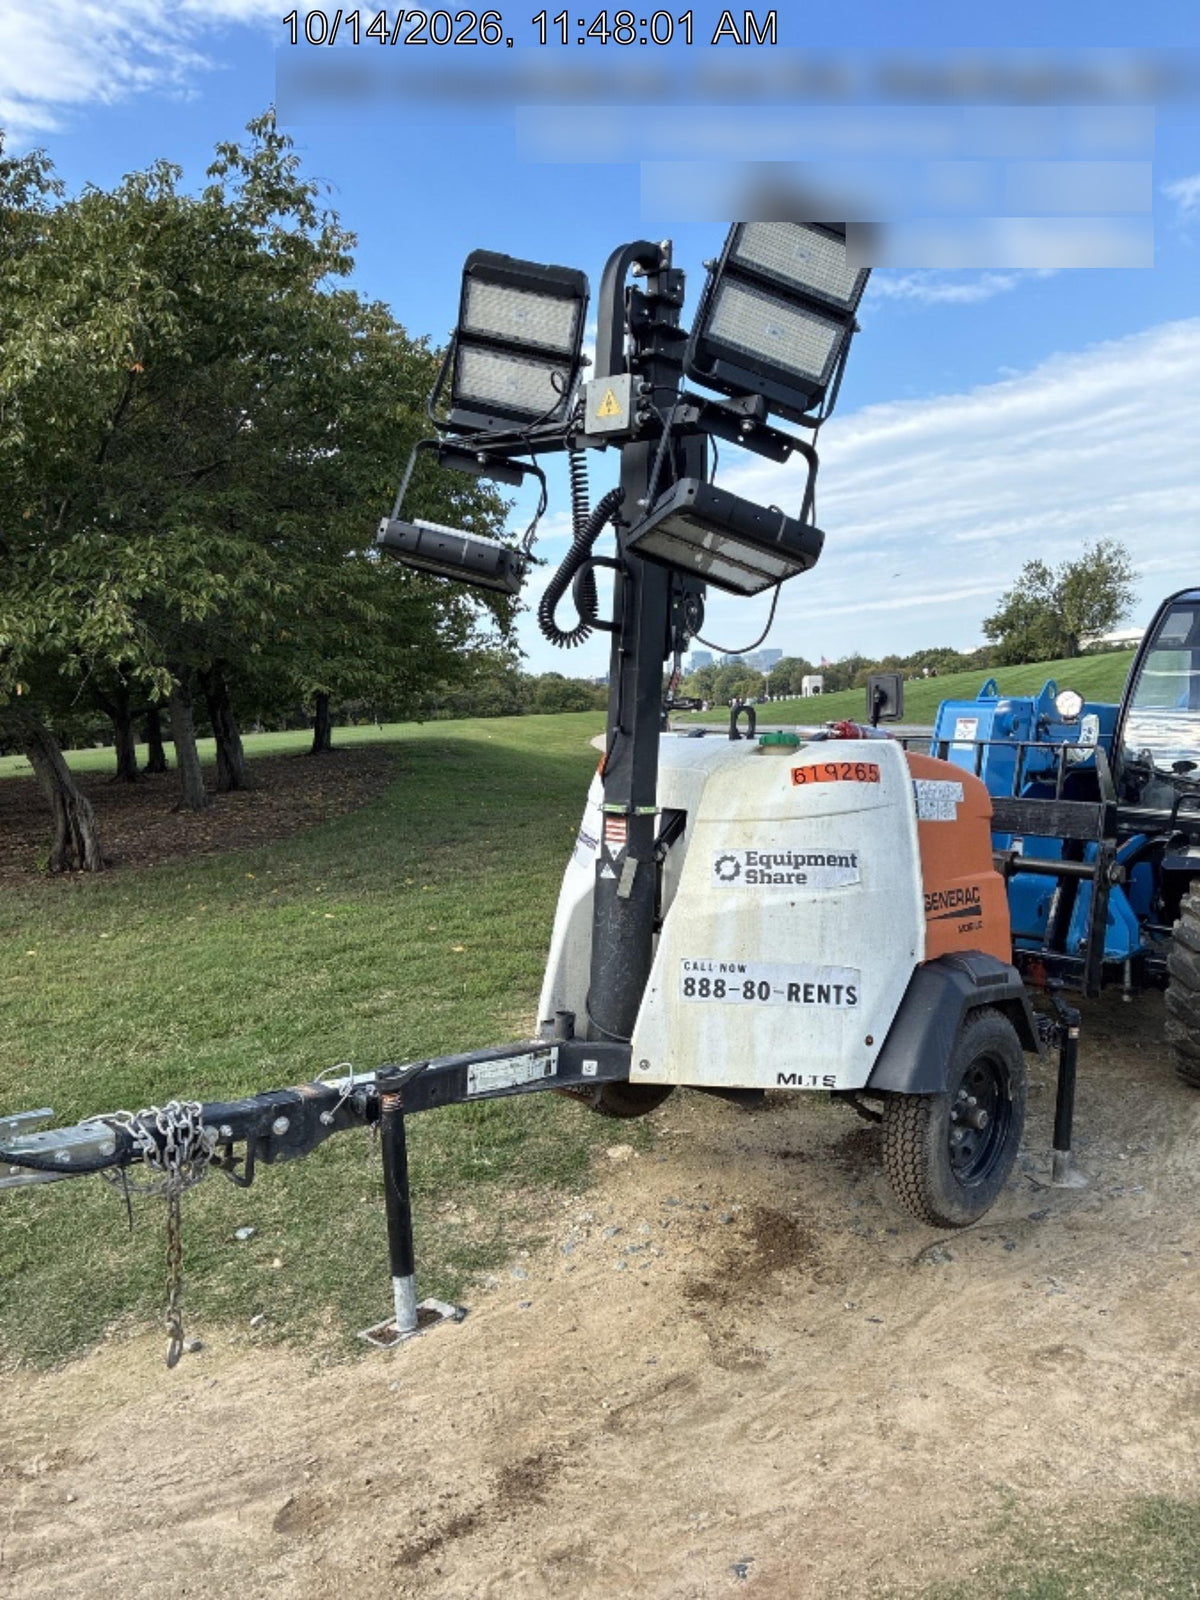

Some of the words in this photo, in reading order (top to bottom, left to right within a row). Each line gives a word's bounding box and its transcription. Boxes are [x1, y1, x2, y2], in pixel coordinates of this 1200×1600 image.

[793, 762, 880, 785] 619265
[745, 851, 858, 870] Equipment
[745, 869, 808, 885] Share
[924, 886, 981, 912] GENERAC
[683, 961, 714, 972] CALL
[719, 963, 748, 974] NOW
[683, 977, 859, 1006] 888-80-RENTS
